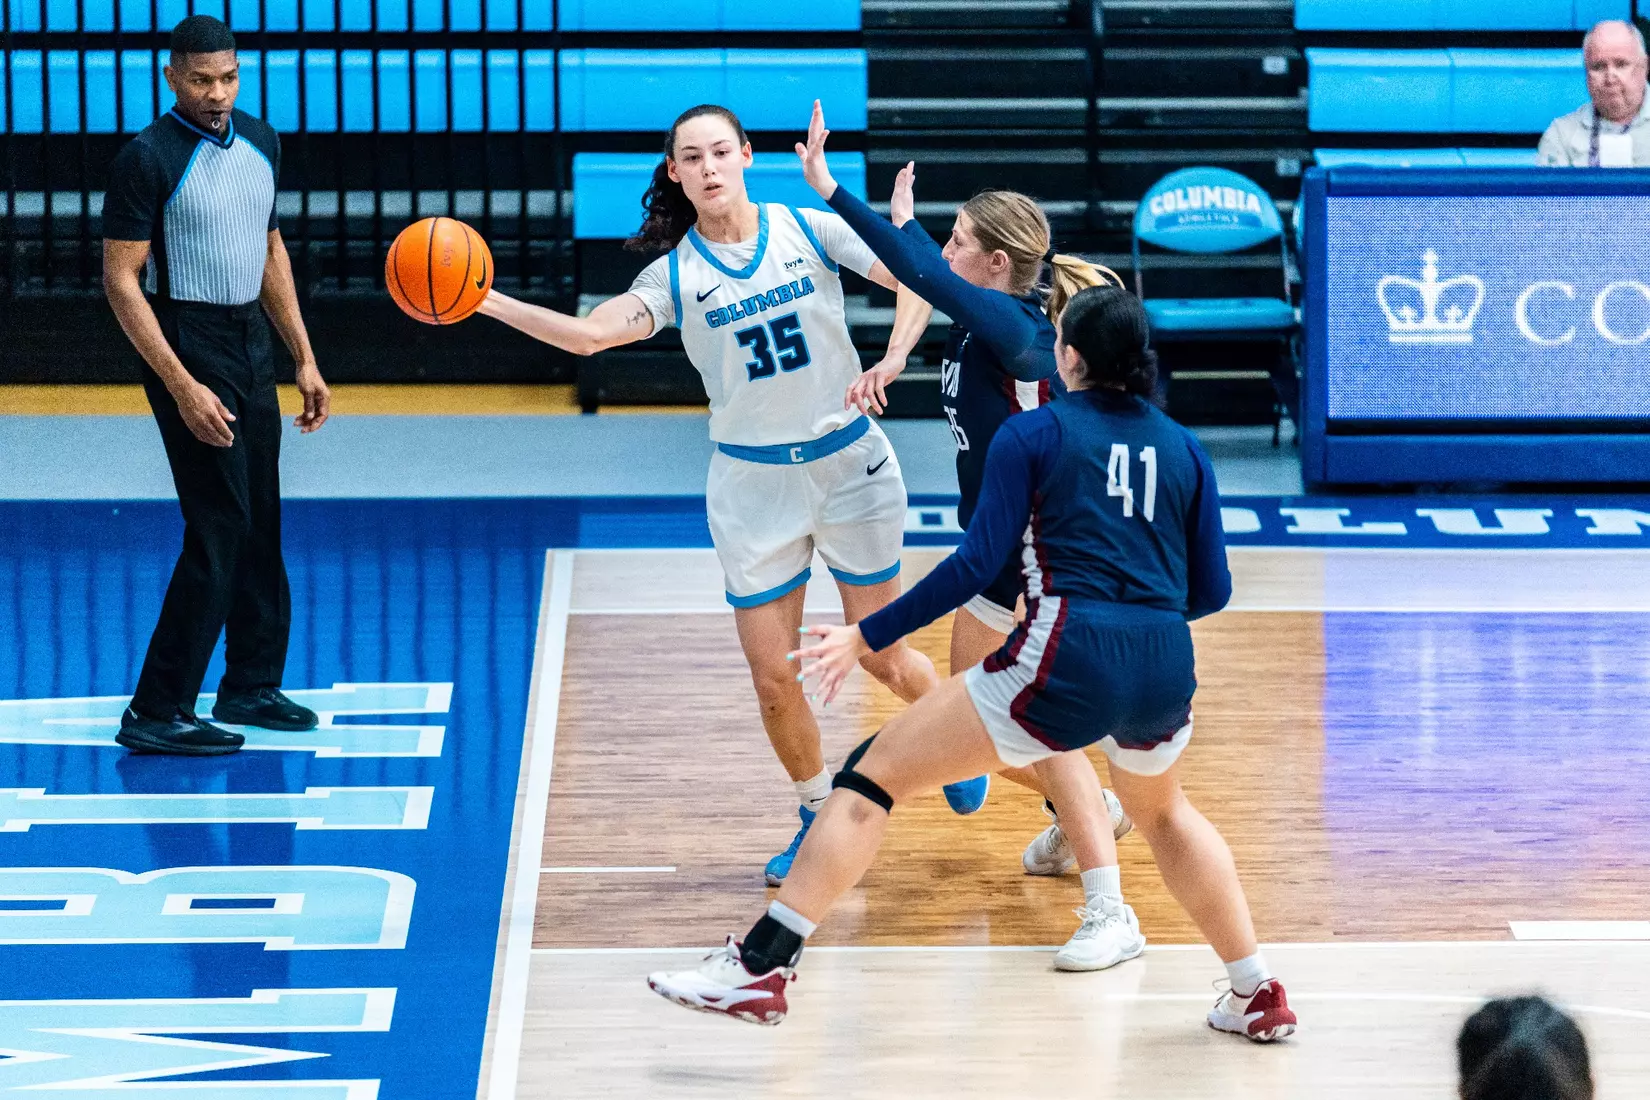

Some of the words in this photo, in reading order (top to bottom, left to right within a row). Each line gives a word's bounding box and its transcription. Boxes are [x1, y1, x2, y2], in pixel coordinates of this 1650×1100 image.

[1150, 185, 1262, 215] COLUMBIA
[784, 259, 797, 270] Ivy
[705, 275, 815, 329] COLUMBIA
[1515, 280, 1650, 346] CO
[733, 310, 812, 383] 35
[789, 446, 804, 463] C
[1107, 443, 1157, 522] 41
